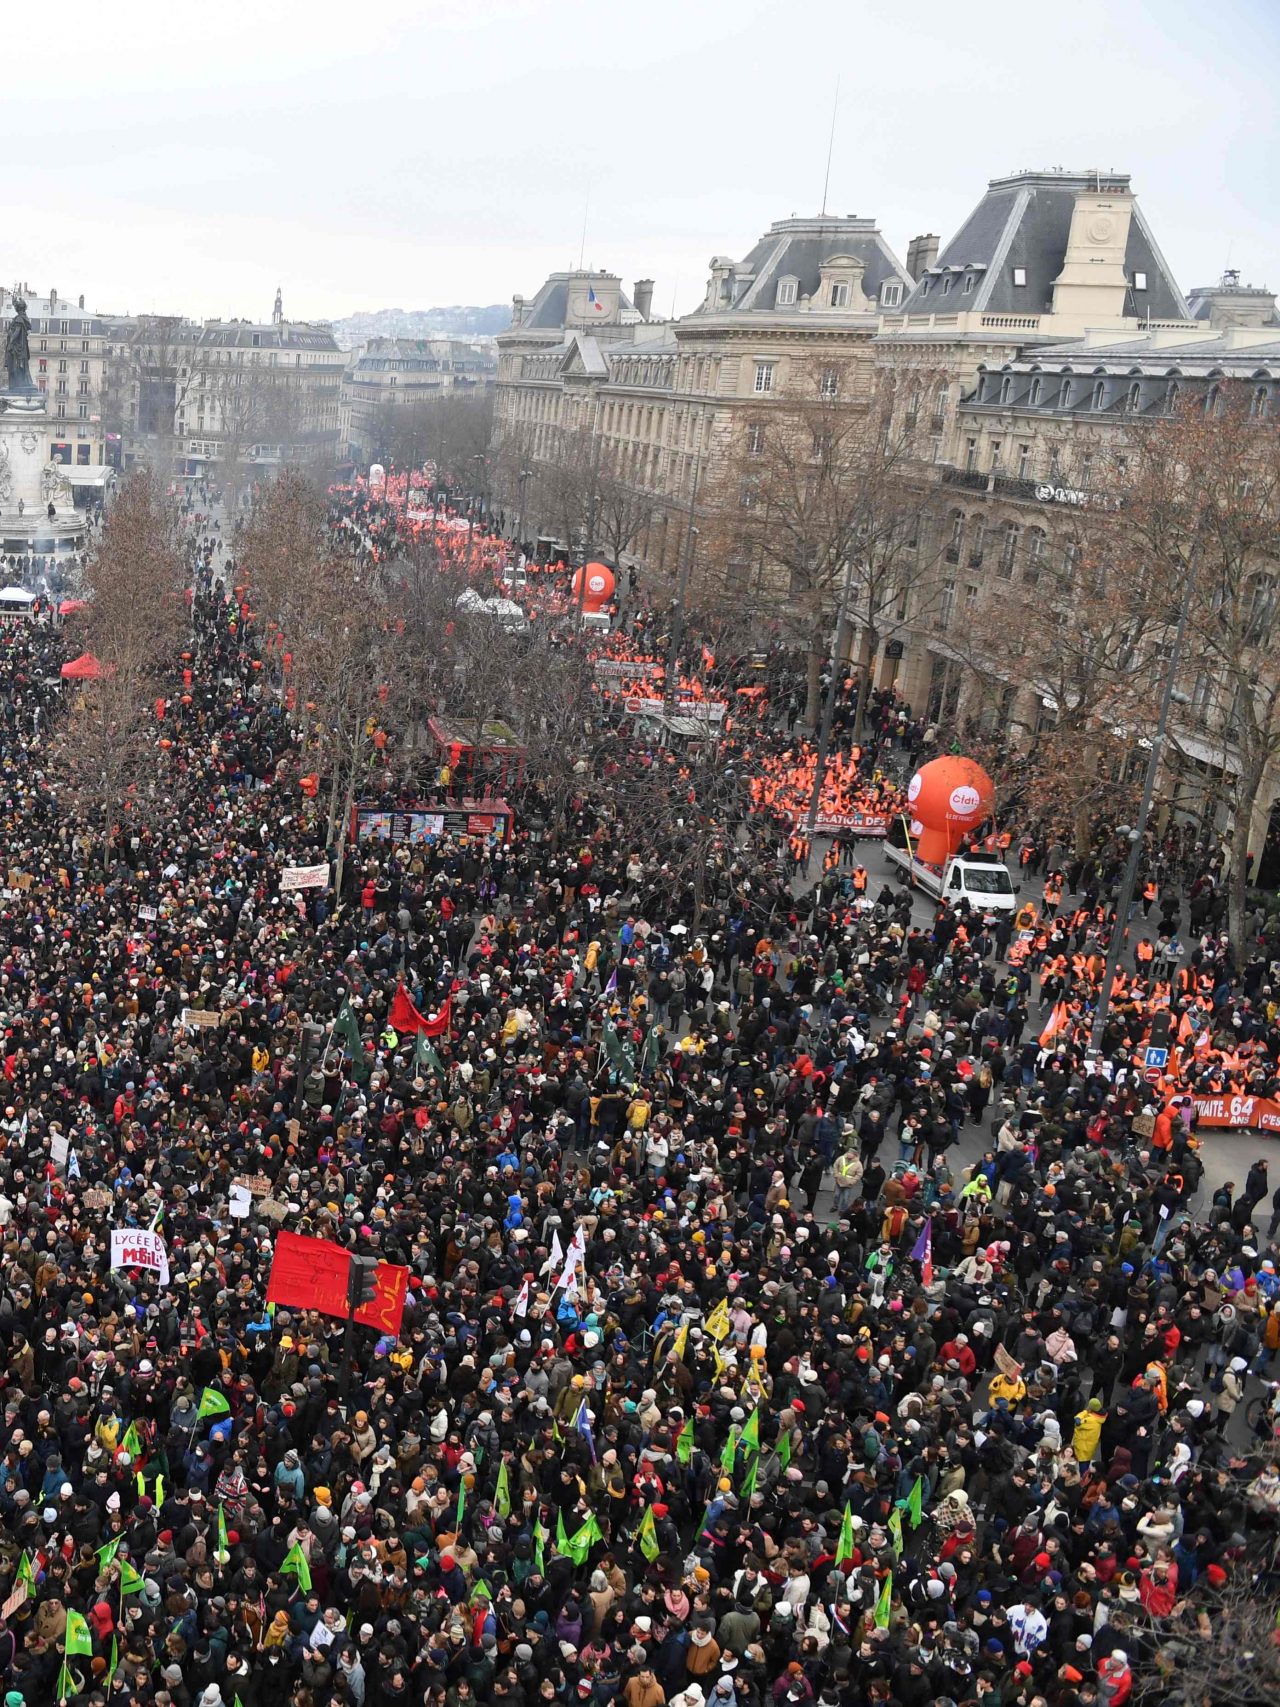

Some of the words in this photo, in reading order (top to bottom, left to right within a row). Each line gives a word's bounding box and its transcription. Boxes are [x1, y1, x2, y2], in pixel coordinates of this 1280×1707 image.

[865, 817, 886, 826] DES
[1230, 1096, 1254, 1116] 64
[1229, 1116, 1250, 1125] ANS
[115, 1232, 150, 1247] LYCÉE
